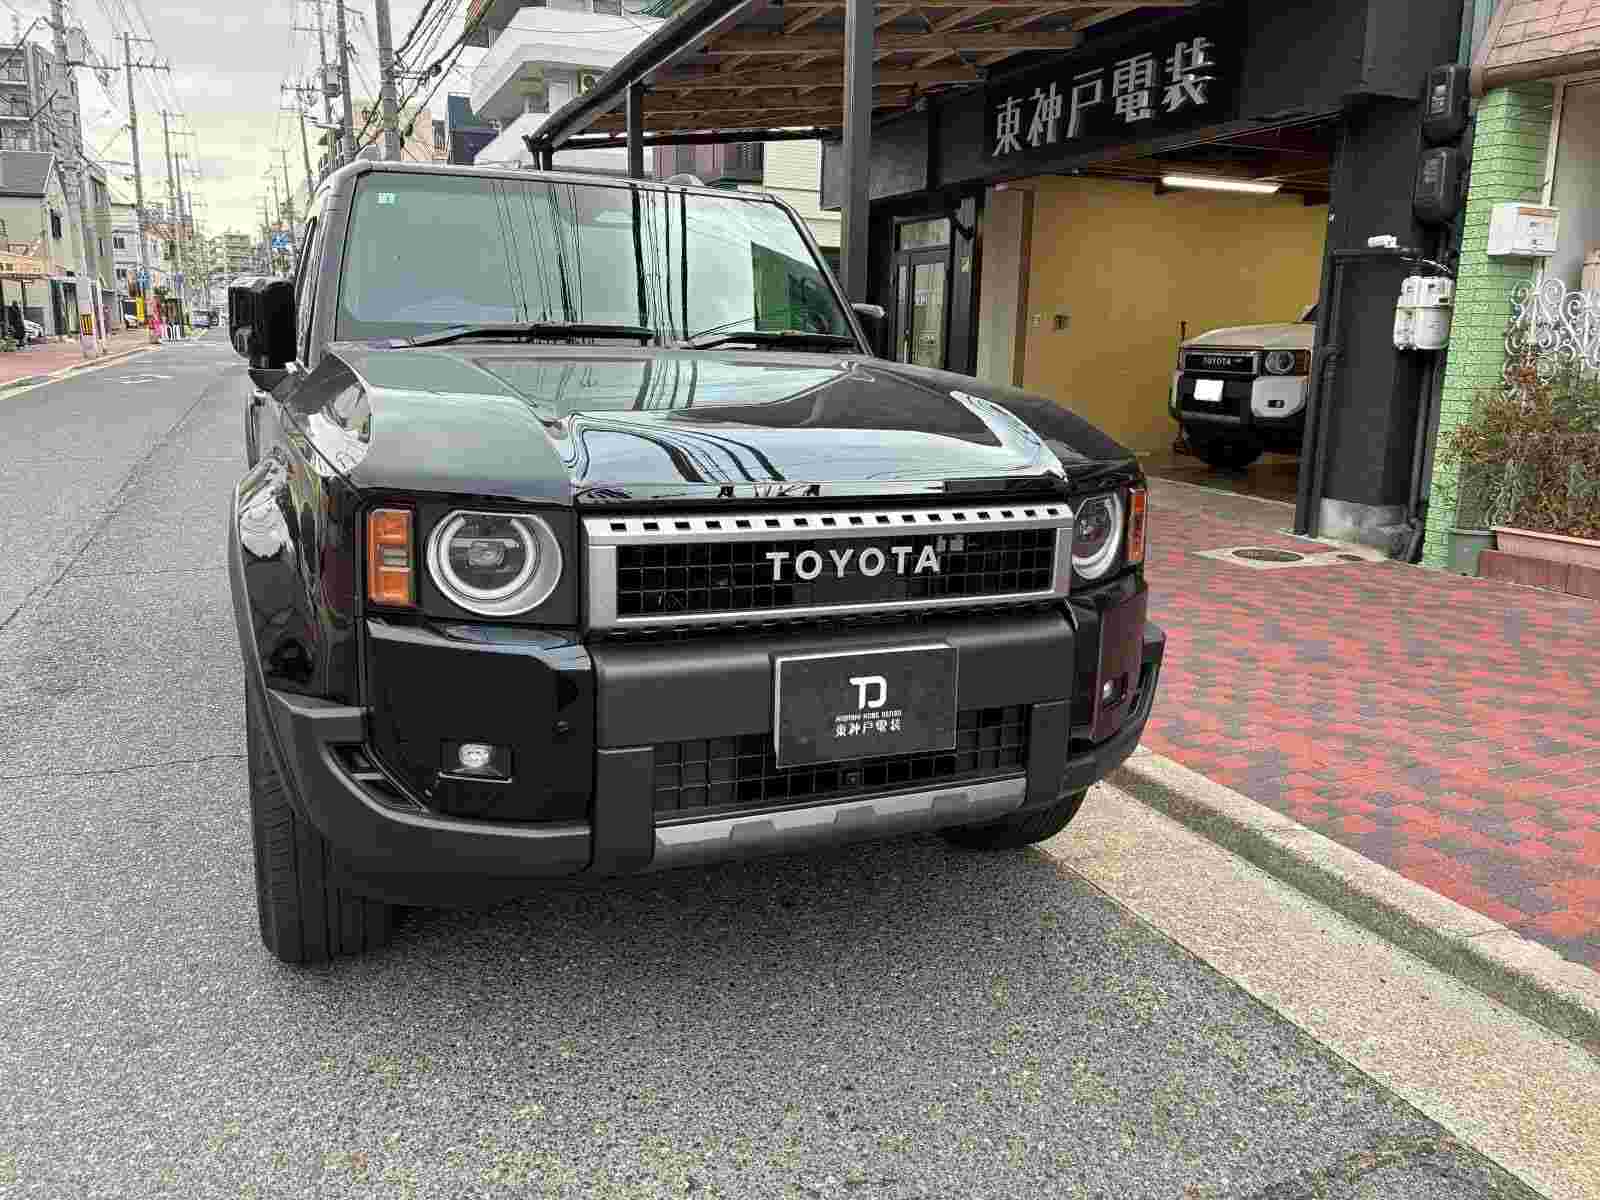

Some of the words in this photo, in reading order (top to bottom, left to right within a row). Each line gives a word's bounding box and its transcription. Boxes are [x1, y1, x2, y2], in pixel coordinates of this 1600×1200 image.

[992, 37, 1216, 157] 東神戸電装
[766, 545, 940, 580] TOYOTA
